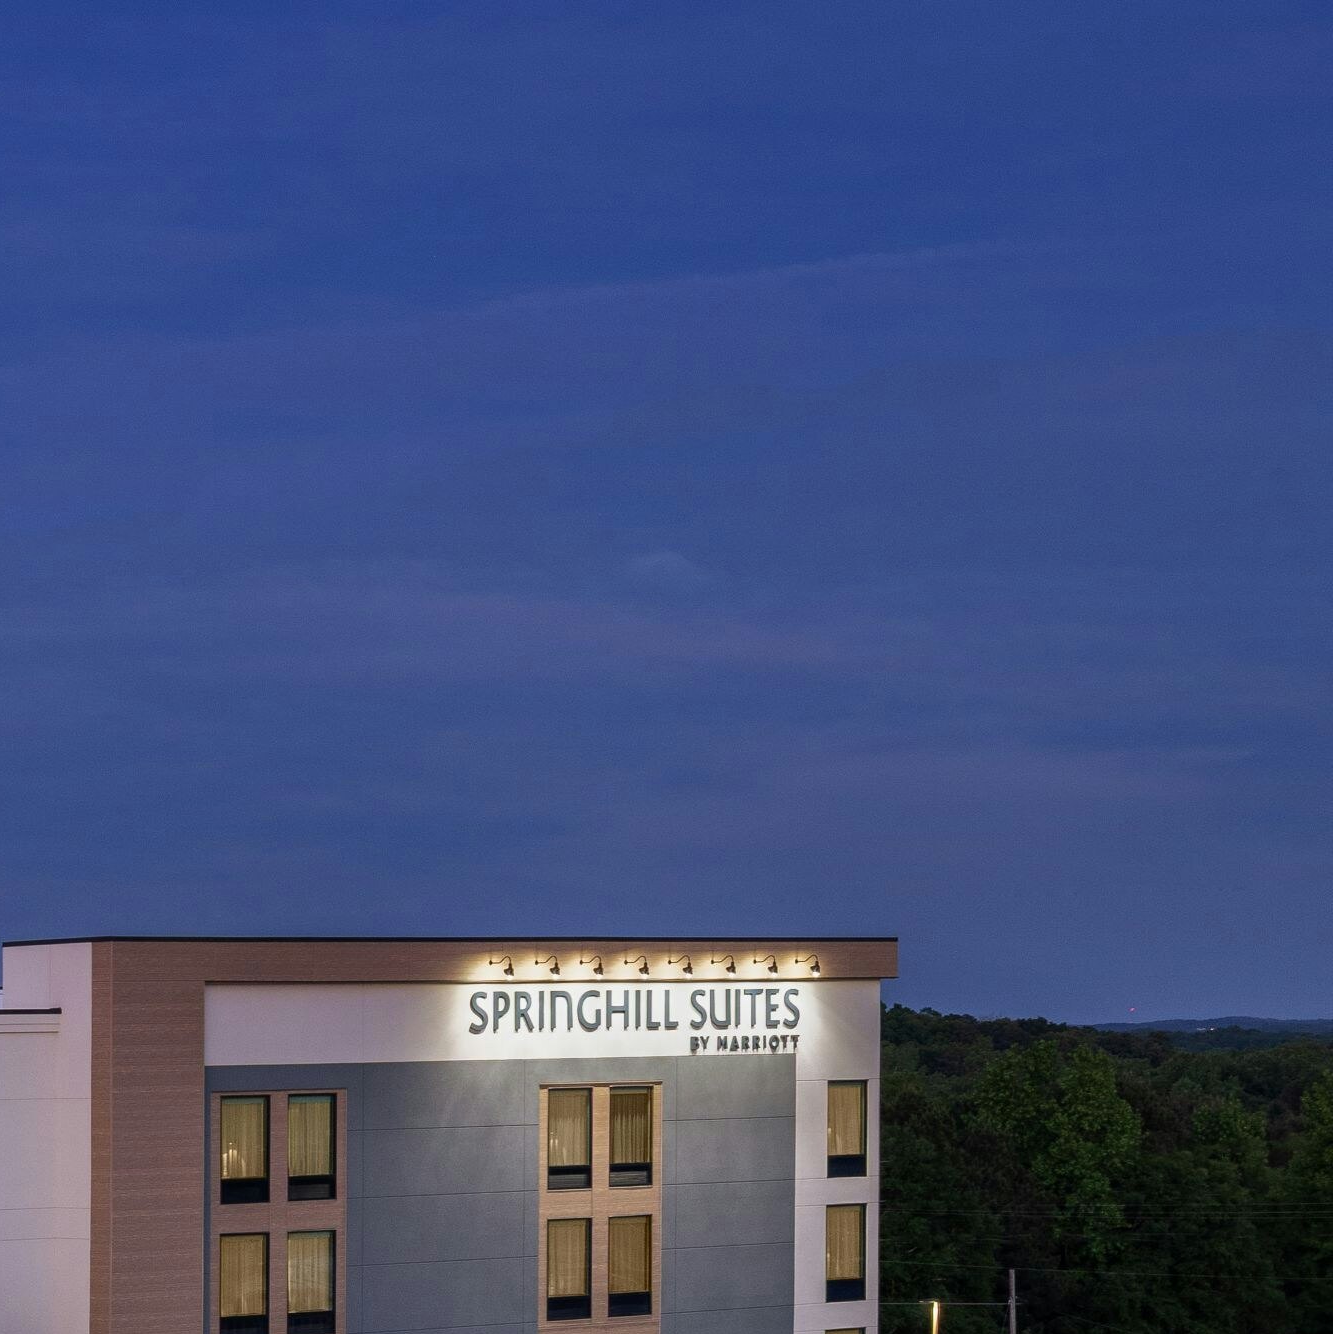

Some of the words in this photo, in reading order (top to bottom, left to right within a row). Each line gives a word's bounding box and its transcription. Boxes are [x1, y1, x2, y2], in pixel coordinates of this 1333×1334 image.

[468, 989, 679, 1033] SPRINGHILL
[689, 988, 801, 1029] SUITES
[689, 1035, 710, 1051] BY
[716, 1034, 800, 1052] MARRIOTT
